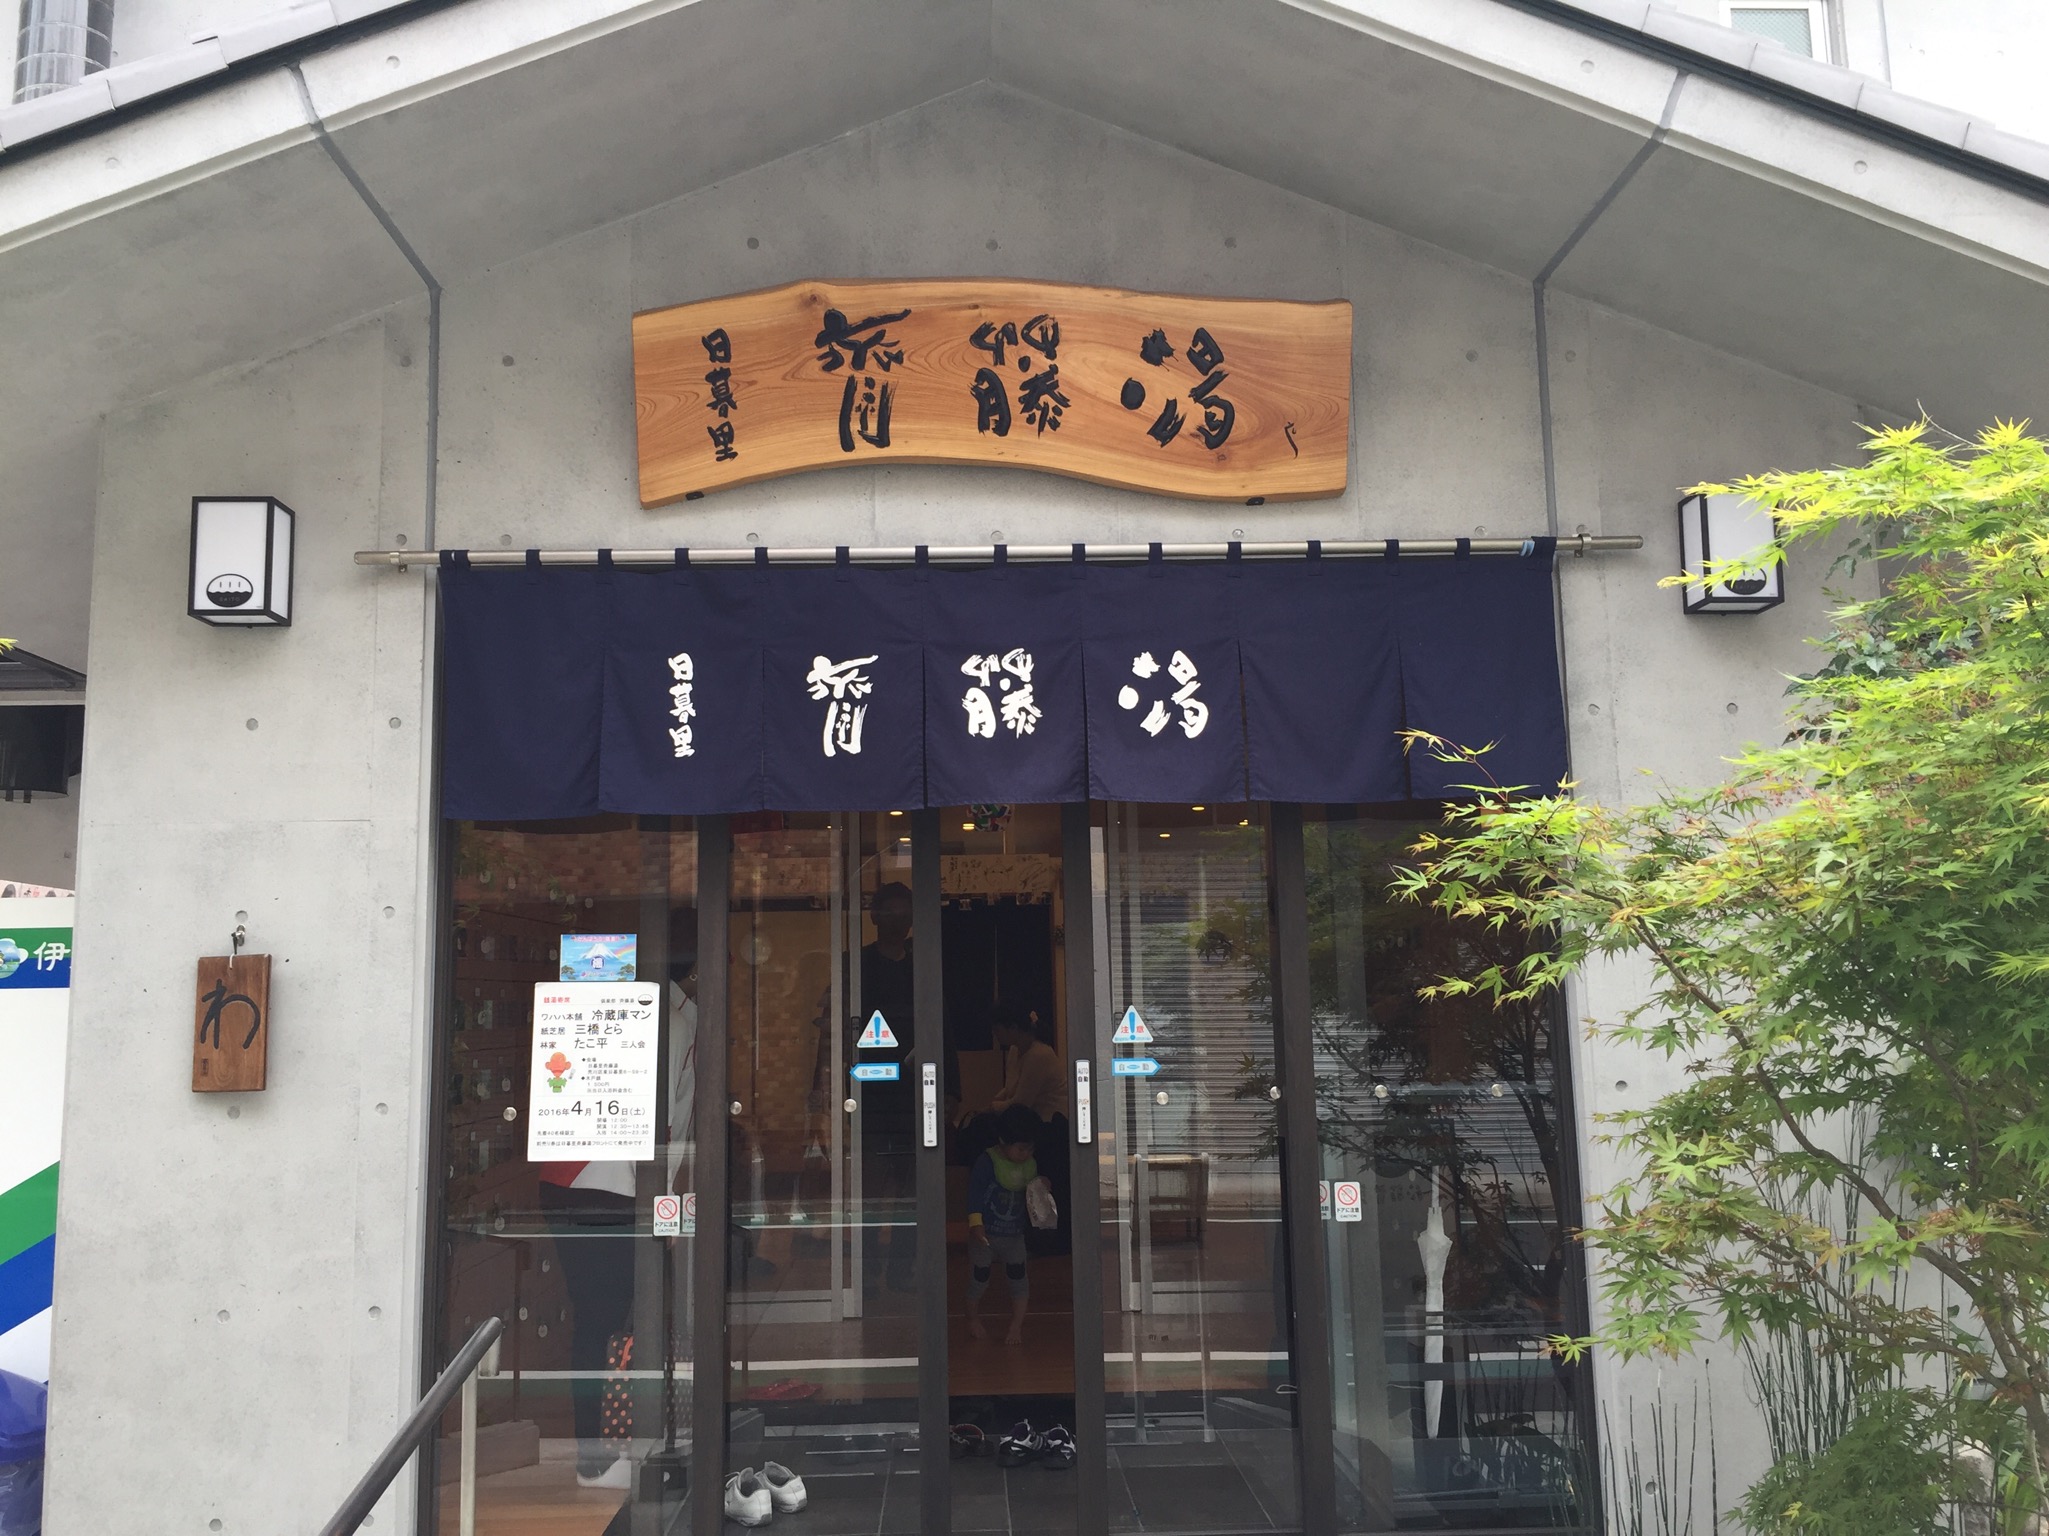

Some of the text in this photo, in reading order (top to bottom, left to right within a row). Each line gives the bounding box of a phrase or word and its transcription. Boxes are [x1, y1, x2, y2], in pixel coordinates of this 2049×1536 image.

[668, 653, 697, 757] 日暮里
[33, 941, 71, 971] 伊
[541, 1009, 652, 1021] ワハハ本舗 冷蔵庫マン
[540, 1023, 623, 1035] 紙芝居 三橋 とら
[866, 1030, 890, 1039] 注意
[1121, 1026, 1145, 1034] 注意
[540, 1038, 646, 1049] 林家 たこ平 三人会
